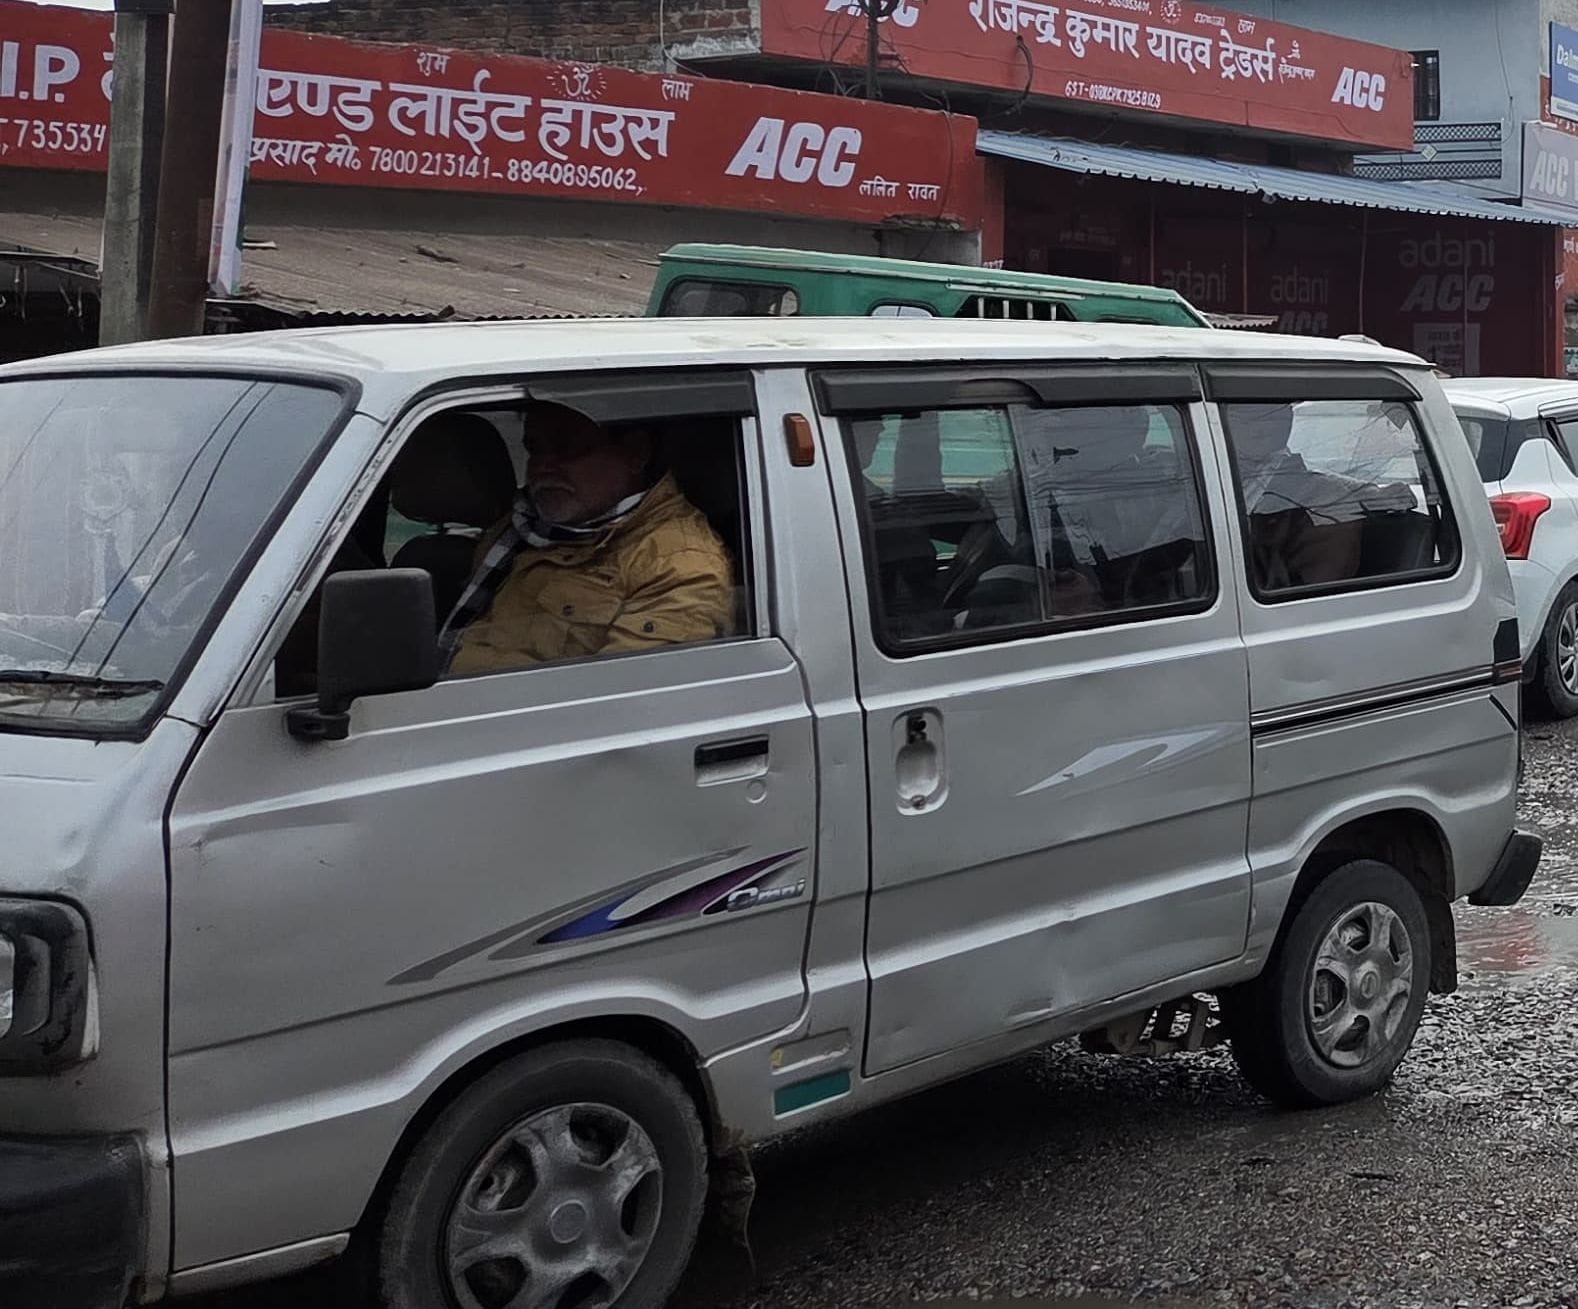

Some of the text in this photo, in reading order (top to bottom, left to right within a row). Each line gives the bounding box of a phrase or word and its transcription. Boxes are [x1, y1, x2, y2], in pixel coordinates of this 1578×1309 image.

[1066, 9, 1139, 58] कुमार
[1146, 26, 1212, 74] यादव
[1218, 28, 1275, 83] ट्रेडर्स
[1331, 66, 1386, 112] ACC
[256, 68, 382, 132] एण्ड
[538, 98, 676, 161] हाउस
[725, 116, 863, 188] ACC
[858, 176, 941, 201] ललित रावत
[1529, 151, 1570, 198] ACC
[1398, 229, 1496, 268] adani
[1270, 265, 1329, 305] adani
[1400, 273, 1496, 313] ACC
[727, 878, 806, 912] Omni
